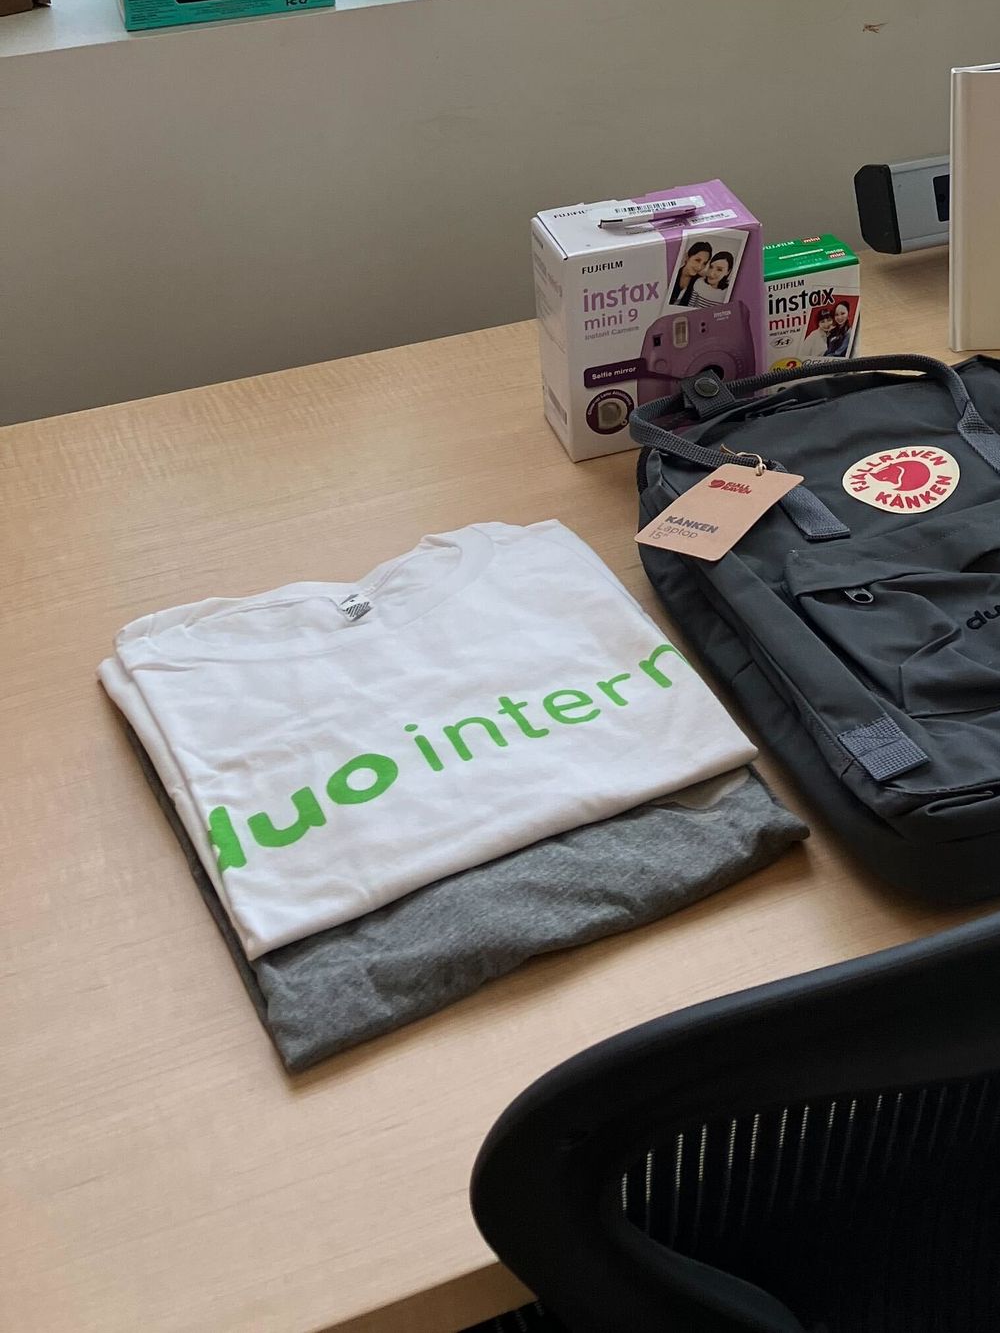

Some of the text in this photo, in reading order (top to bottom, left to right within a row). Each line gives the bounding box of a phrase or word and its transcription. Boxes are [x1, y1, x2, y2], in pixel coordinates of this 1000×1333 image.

[582, 261, 623, 274] FUJIFILM
[768, 279, 805, 292] FUJIFILM
[583, 281, 660, 313] instax
[768, 286, 835, 315] instax
[584, 308, 638, 331] mini 9
[769, 311, 807, 331] mini
[585, 330, 610, 341] Instant
[614, 367, 637, 377] mirror
[875, 475, 953, 509] KÅNKEN
[657, 523, 698, 539] Laptop
[403, 643, 692, 773] intern
